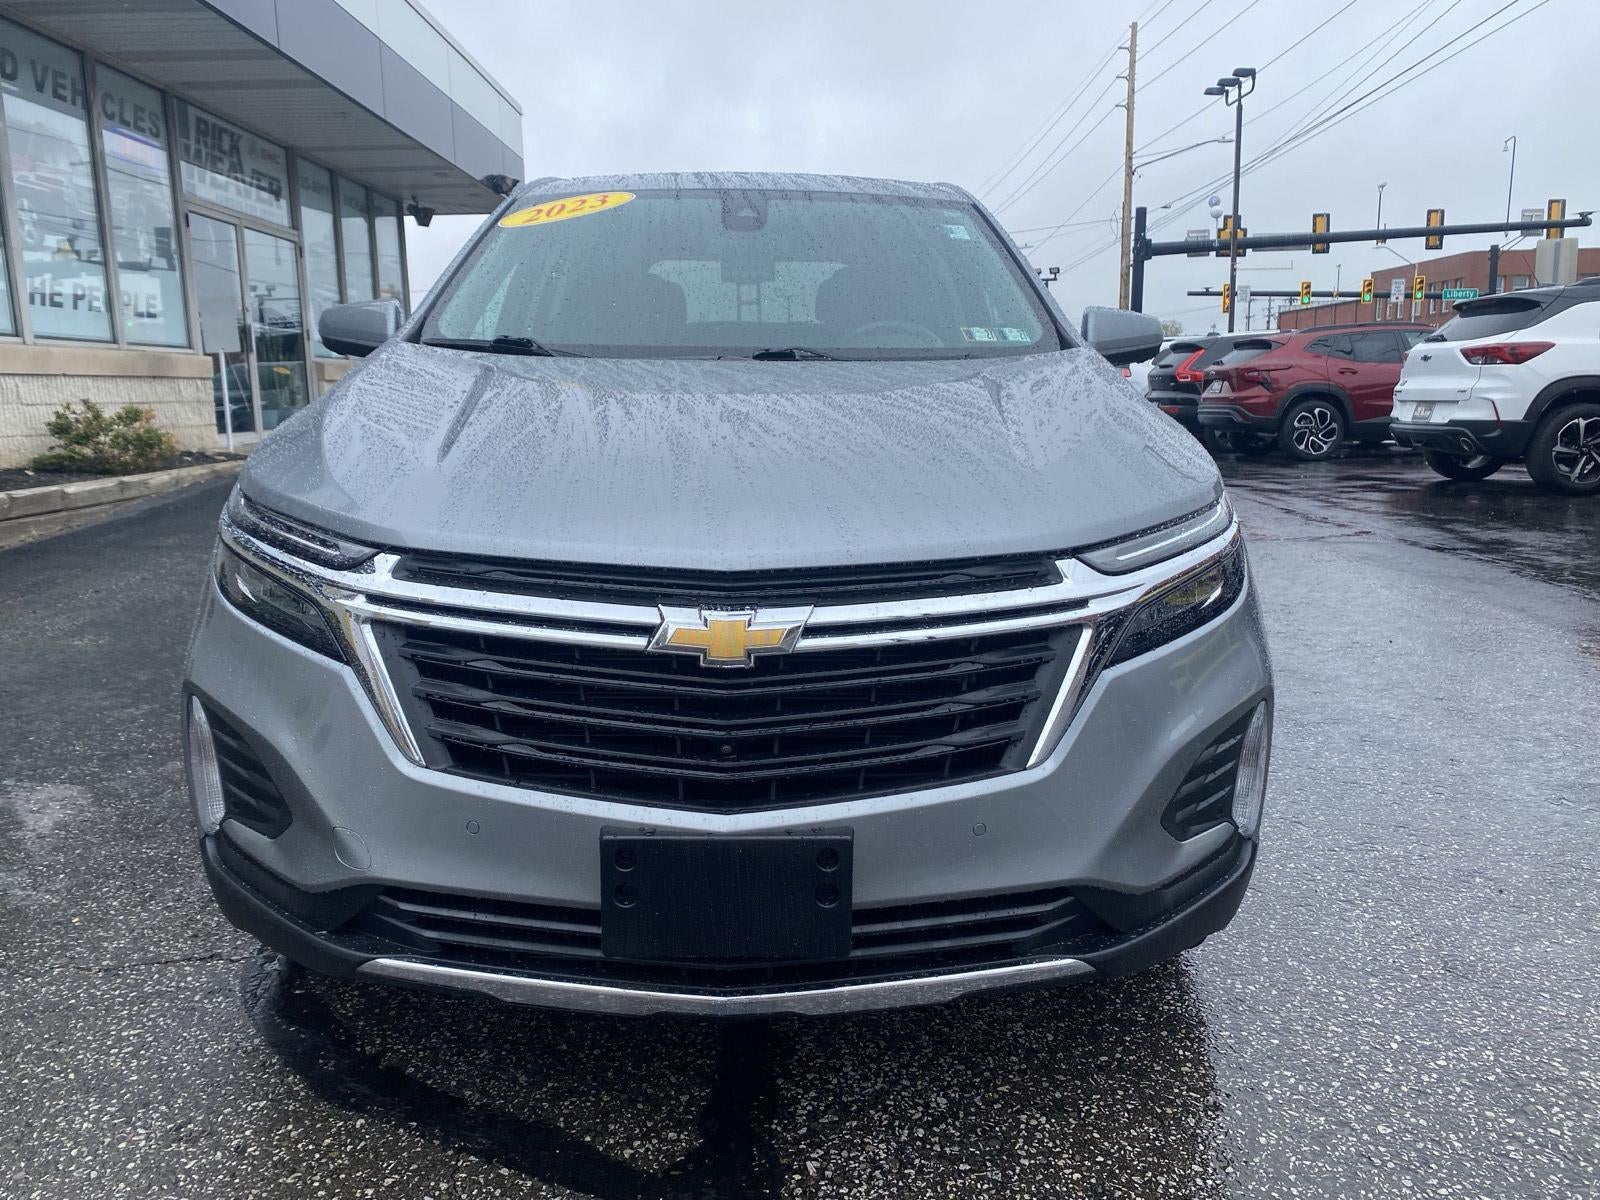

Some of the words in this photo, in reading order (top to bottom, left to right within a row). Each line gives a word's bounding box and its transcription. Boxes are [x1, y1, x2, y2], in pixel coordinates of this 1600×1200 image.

[29, 58, 161, 138] VEHCLES
[194, 115, 244, 160] RICK
[522, 194, 609, 224] 2023
[28, 277, 64, 309] HE
[72, 282, 158, 319] PEPLE
[1446, 289, 1475, 300] Liberty
